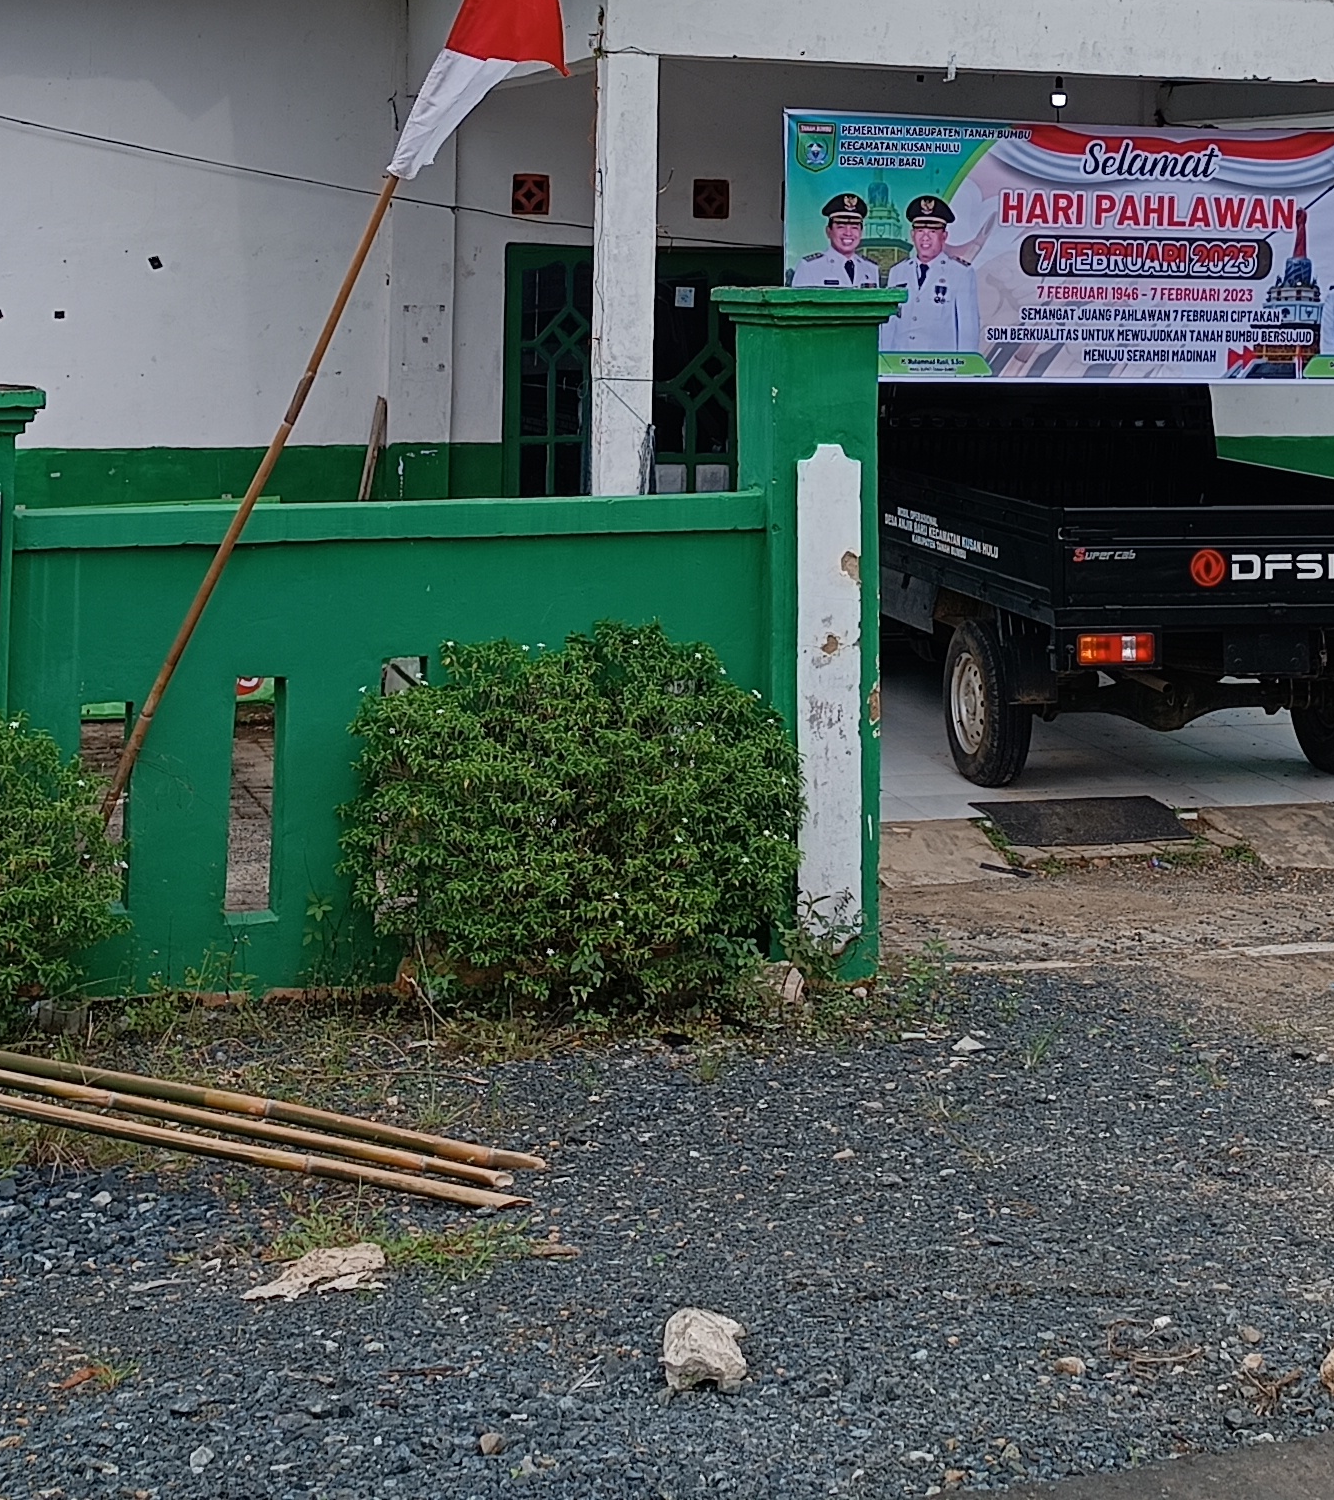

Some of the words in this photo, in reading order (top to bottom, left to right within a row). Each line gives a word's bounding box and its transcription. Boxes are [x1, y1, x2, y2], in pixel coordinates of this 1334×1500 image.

[840, 125, 903, 137] PEMERINTAH
[905, 127, 961, 138] KABUPATEN
[963, 128, 995, 139] TANAH
[997, 129, 1032, 140] BUMBU
[840, 141, 899, 152] KECAMATAN
[900, 142, 933, 152] KUSAN
[934, 143, 960, 153] HULU
[839, 156, 865, 167] DESA
[866, 156, 896, 167] ANJIR
[898, 157, 924, 168] BARU
[1082, 141, 1220, 178] Selamat
[1001, 191, 1085, 225] HARI
[1094, 193, 1295, 230] PAHLAWAN
[1036, 239, 1056, 272] 7
[1059, 240, 1188, 275] FEBRUARI
[1191, 242, 1258, 275] 2023
[1036, 285, 1045, 299] 7
[1047, 286, 1109, 300] FEBRUARI
[1111, 286, 1139, 301] 1946
[1150, 287, 1158, 301] 7
[1160, 287, 1220, 302] FEBRUARI
[1223, 288, 1254, 302] 2023
[1020, 307, 1076, 321] SEMANGAT
[1077, 308, 1112, 321] JUANG
[1113, 308, 1171, 322] PAHLAWAN
[1172, 309, 1179, 322] 7
[1180, 309, 1229, 323] FEBRUARI
[986, 327, 1008, 341] SDM
[1010, 328, 1079, 341] BERKUALITAS
[1081, 328, 1115, 342] UNTUK
[1116, 328, 1187, 342] MEWUJUDKAN
[1188, 329, 1224, 342] TANAH
[1225, 330, 1259, 343] BUMBU
[1260, 330, 1313, 343] BERSUJUD
[1083, 348, 1125, 362] MENUJU
[1126, 348, 1170, 362] SERAMBI
[1171, 349, 1217, 362] MADINAH
[928, 526, 961, 547] KECAMATAN
